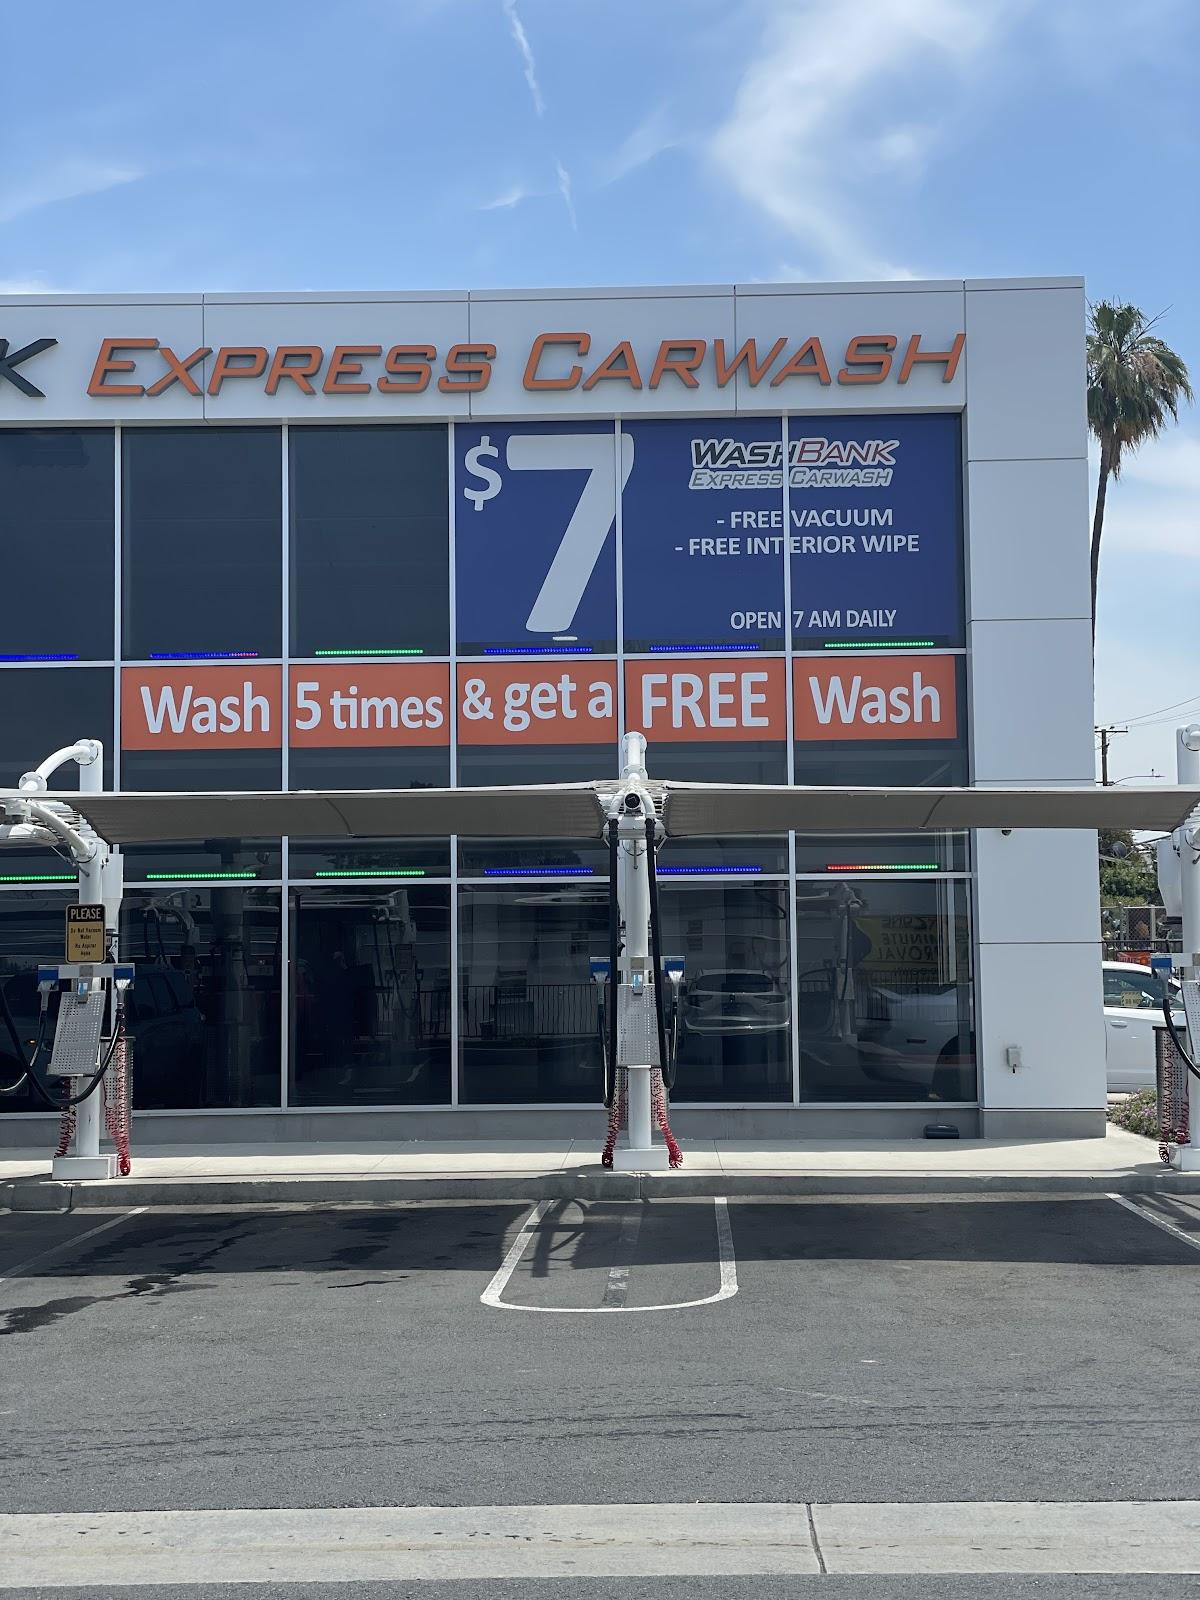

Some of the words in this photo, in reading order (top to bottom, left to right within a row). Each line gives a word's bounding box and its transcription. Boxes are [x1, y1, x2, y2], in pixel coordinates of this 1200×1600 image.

[87, 338, 496, 397] EXPRESS
[523, 332, 966, 391] CARWASH
[691, 471, 783, 487] EXPRESS
[790, 470, 890, 486] CARWASH
[730, 511, 782, 529] FREE
[791, 508, 893, 527] VACUUM
[689, 538, 741, 556] FREE
[747, 535, 856, 554] INTERIOR
[861, 534, 920, 552] WIPE
[730, 611, 782, 629] OPEN
[793, 610, 804, 628] 7
[808, 610, 841, 628] AM
[846, 609, 897, 627] DAILY
[140, 681, 270, 734] Wash
[295, 681, 322, 730] 5
[330, 685, 444, 729] times
[462, 678, 494, 720] &
[503, 674, 577, 732] get
[587, 680, 613, 718] a
[641, 672, 769, 729] FREE
[808, 671, 941, 724] Wash
[70, 908, 102, 919] PLEASE
